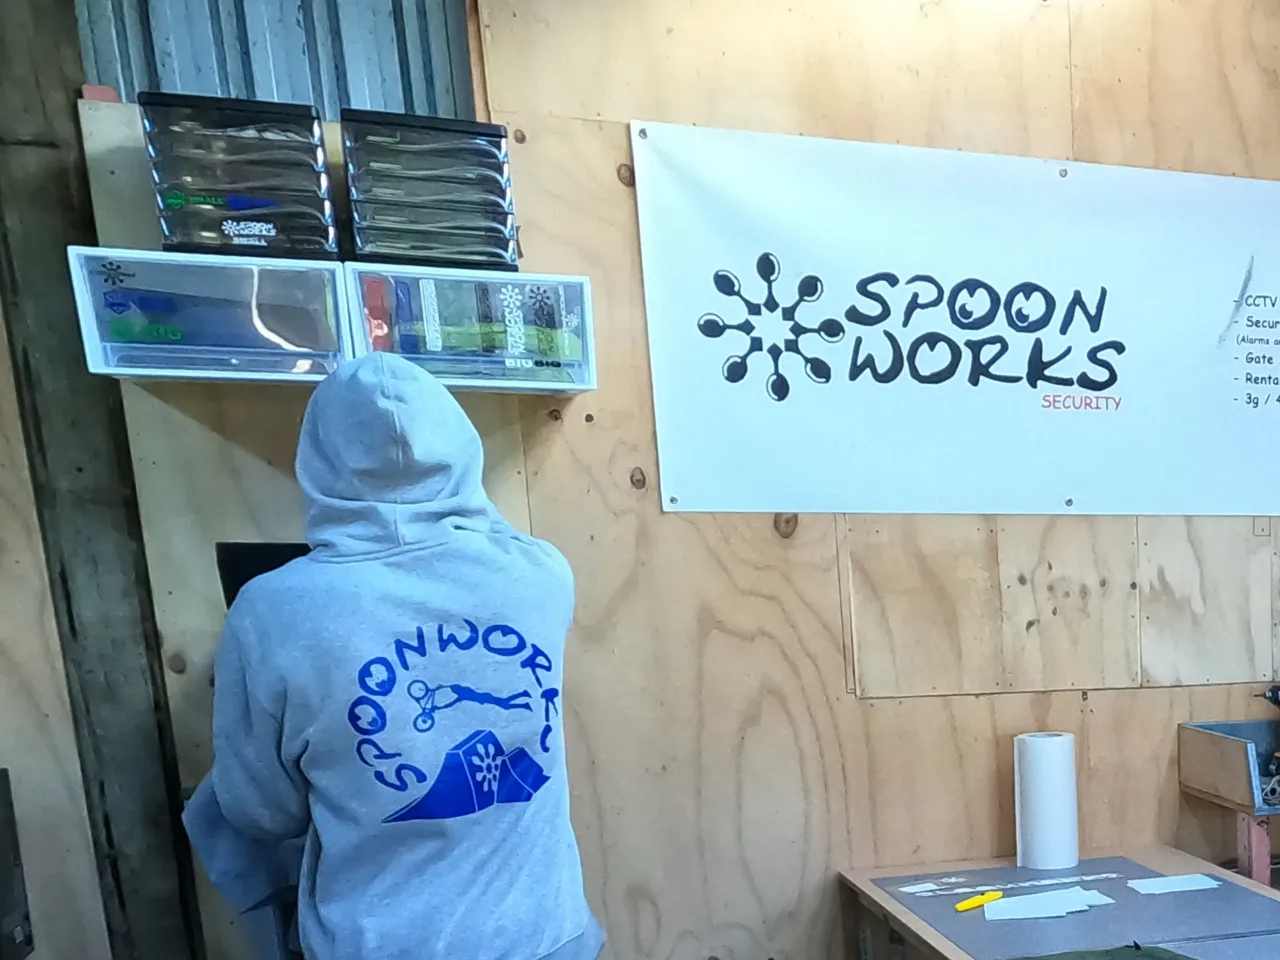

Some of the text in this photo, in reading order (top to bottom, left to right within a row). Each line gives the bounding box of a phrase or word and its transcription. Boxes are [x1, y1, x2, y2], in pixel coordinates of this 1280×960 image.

[844, 271, 1108, 336] SPOON
[1244, 294, 1278, 308] CCTV
[1236, 333, 1270, 346] (Alarms
[848, 329, 1127, 392] WORKS
[1245, 351, 1274, 365] Gate
[1041, 394, 1123, 411] SECURITY
[1244, 392, 1260, 408] 3g
